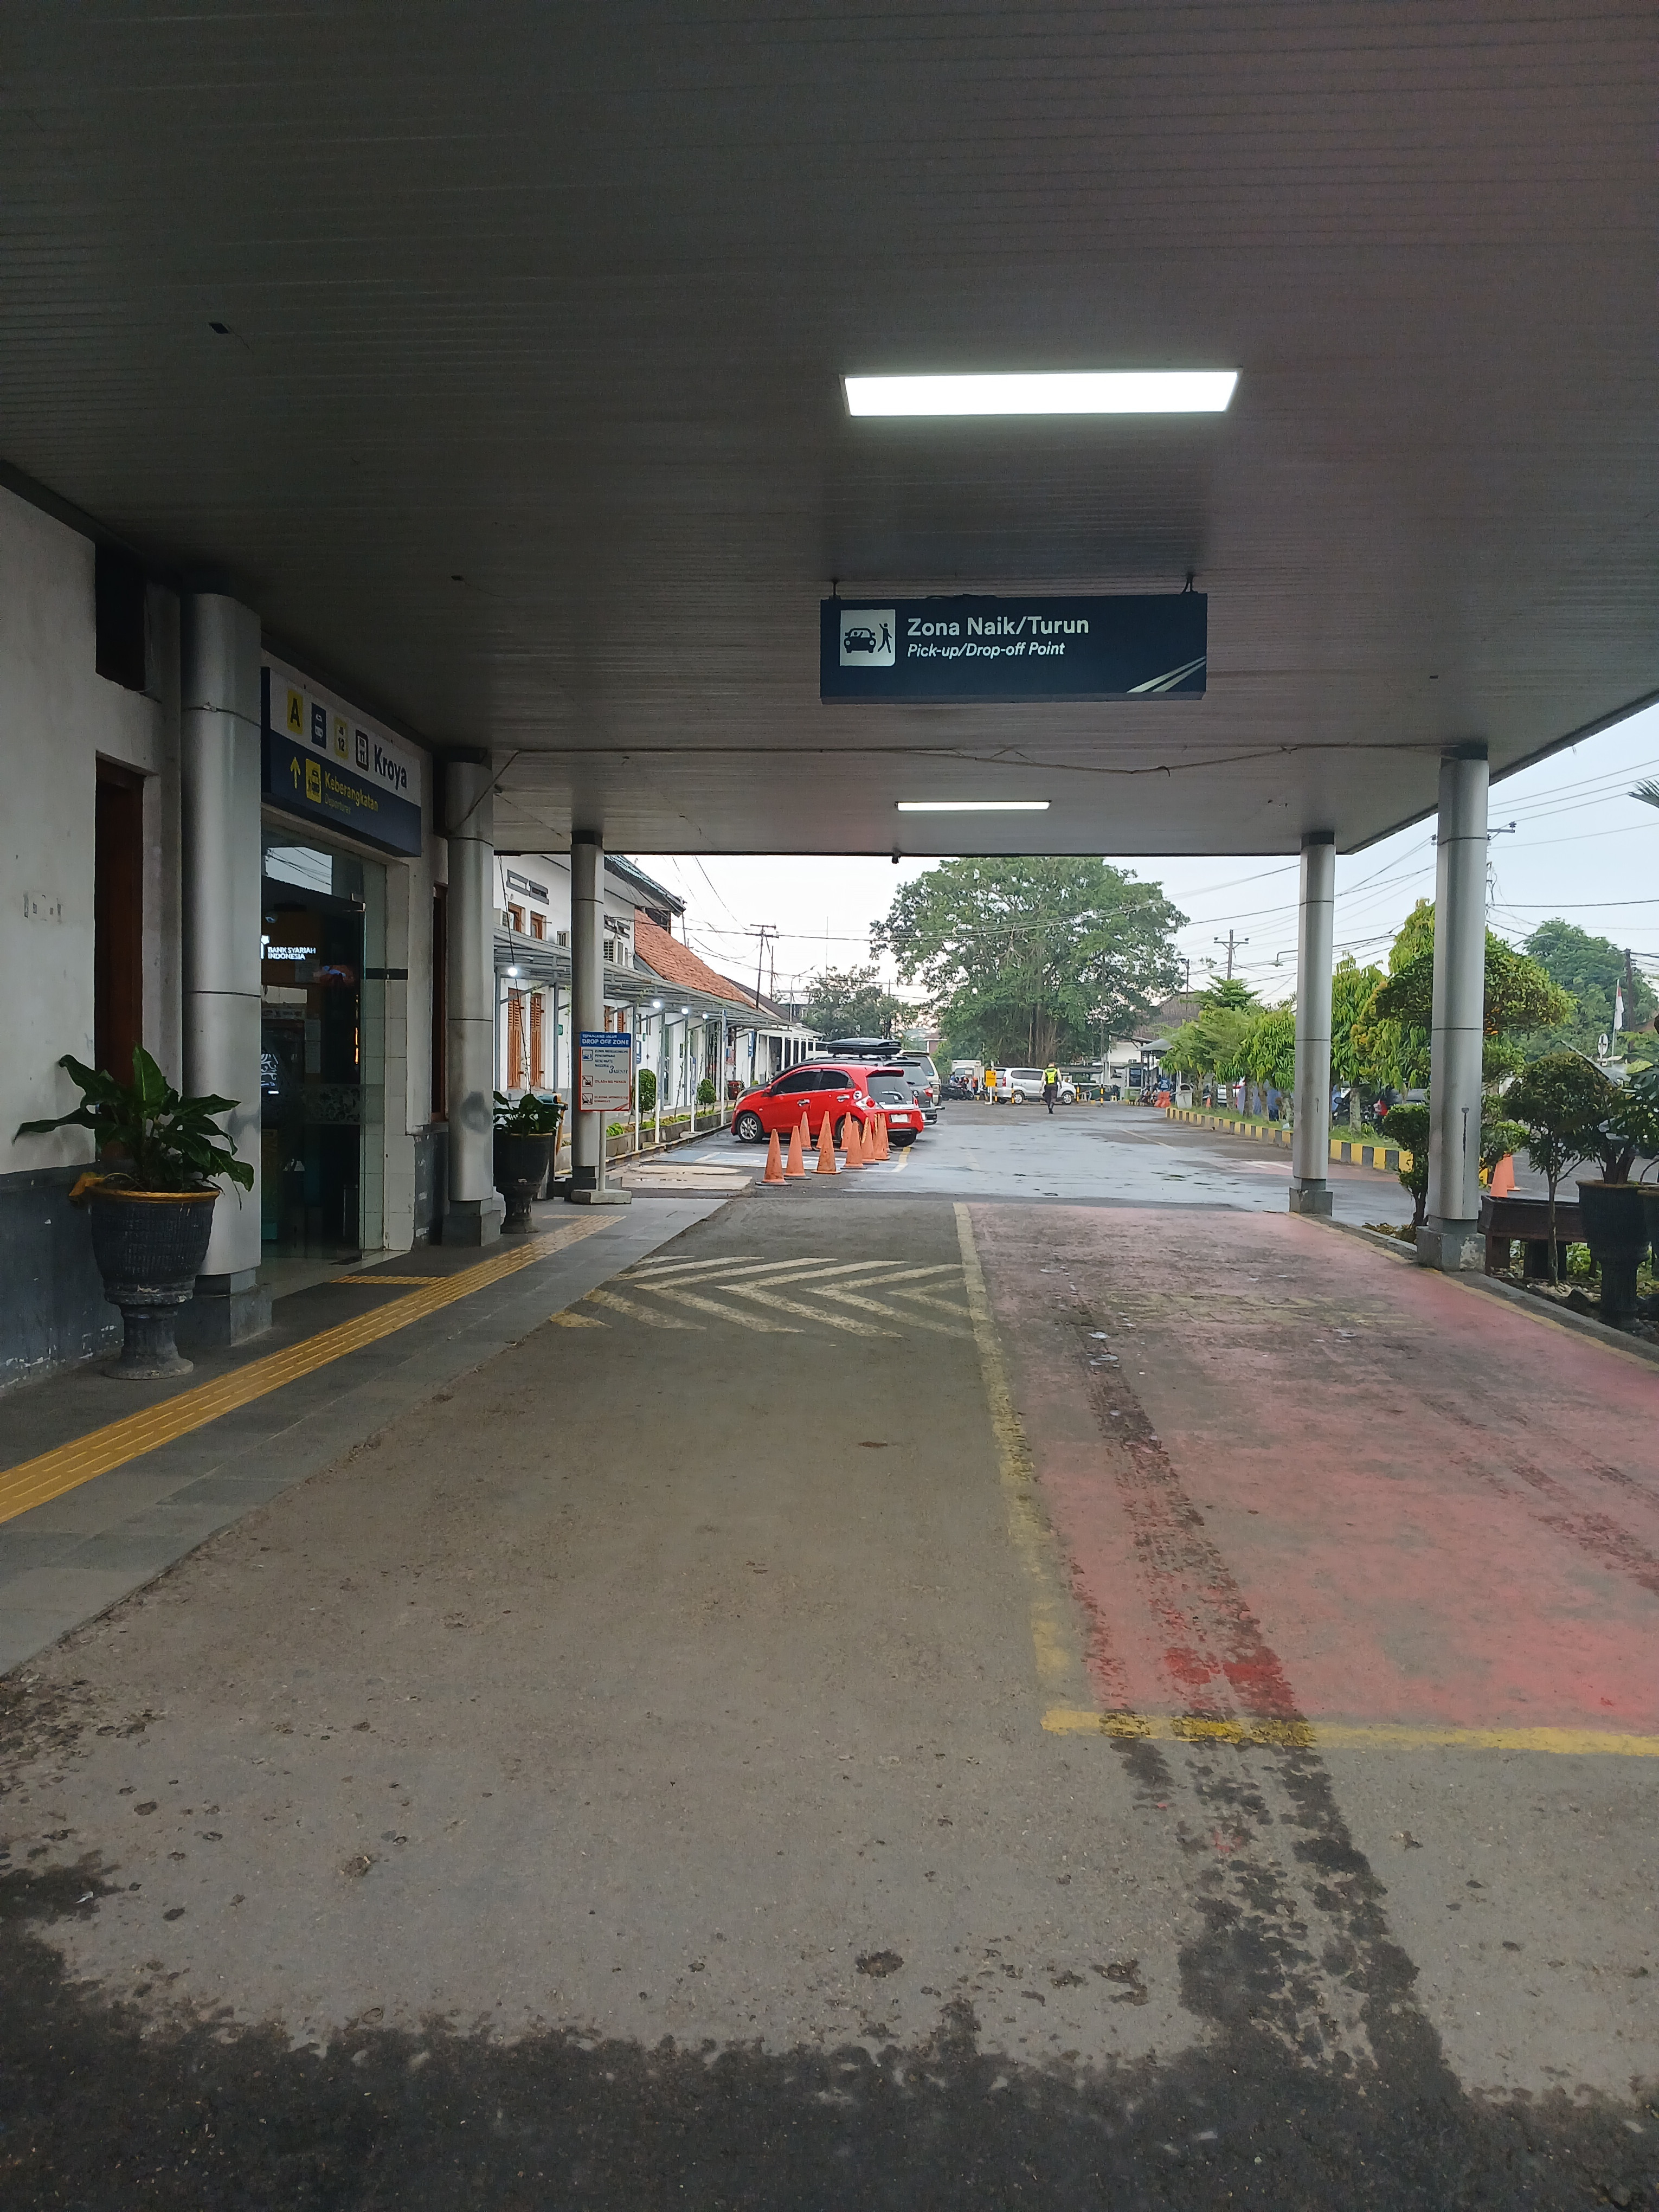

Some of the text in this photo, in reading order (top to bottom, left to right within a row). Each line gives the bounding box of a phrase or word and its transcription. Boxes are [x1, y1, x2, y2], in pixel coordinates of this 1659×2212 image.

[908, 616, 1089, 636] Zona Naik/Turun
[908, 641, 1065, 660] Pick-up/Drop-off Point
[290, 698, 300, 728] A
[374, 743, 408, 790] Kroya
[325, 770, 378, 812] Keberangkatan
[608, 1065, 614, 1073] 3
